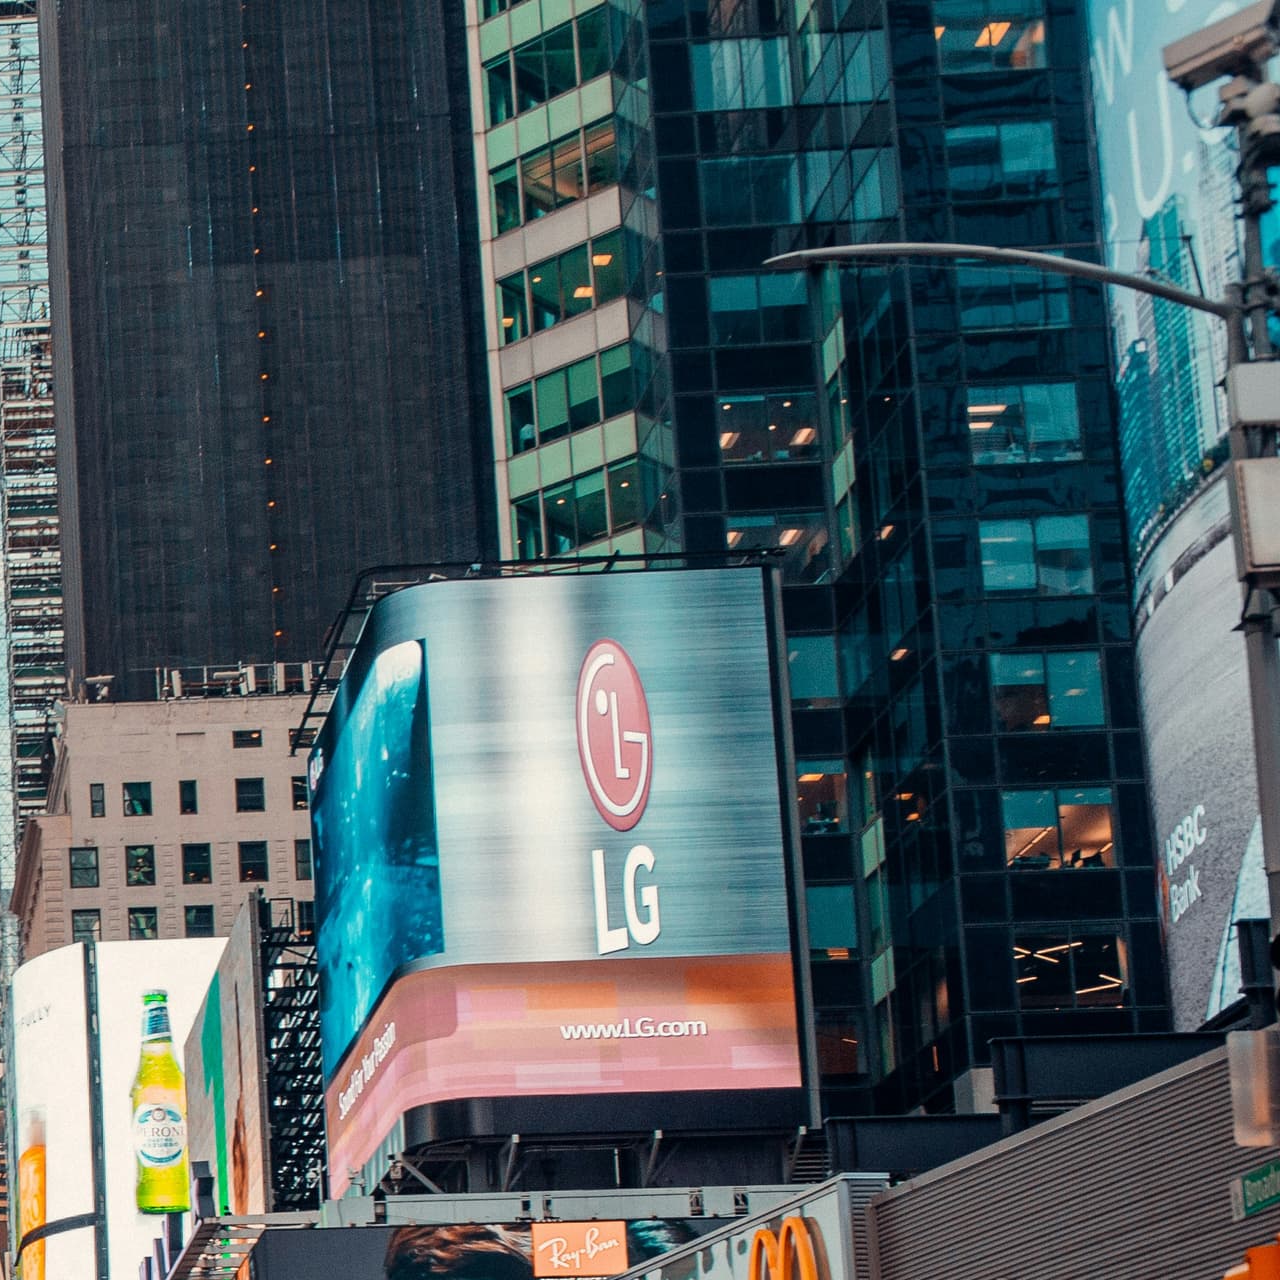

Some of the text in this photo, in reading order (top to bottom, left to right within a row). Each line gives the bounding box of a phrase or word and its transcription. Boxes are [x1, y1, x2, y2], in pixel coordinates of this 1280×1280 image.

[1166, 804, 1207, 877] HSBC
[592, 845, 661, 954] LG
[1170, 866, 1203, 924] Bank
[561, 1016, 707, 1040] www.LG.com
[538, 1227, 620, 1269] Ray-Ban
